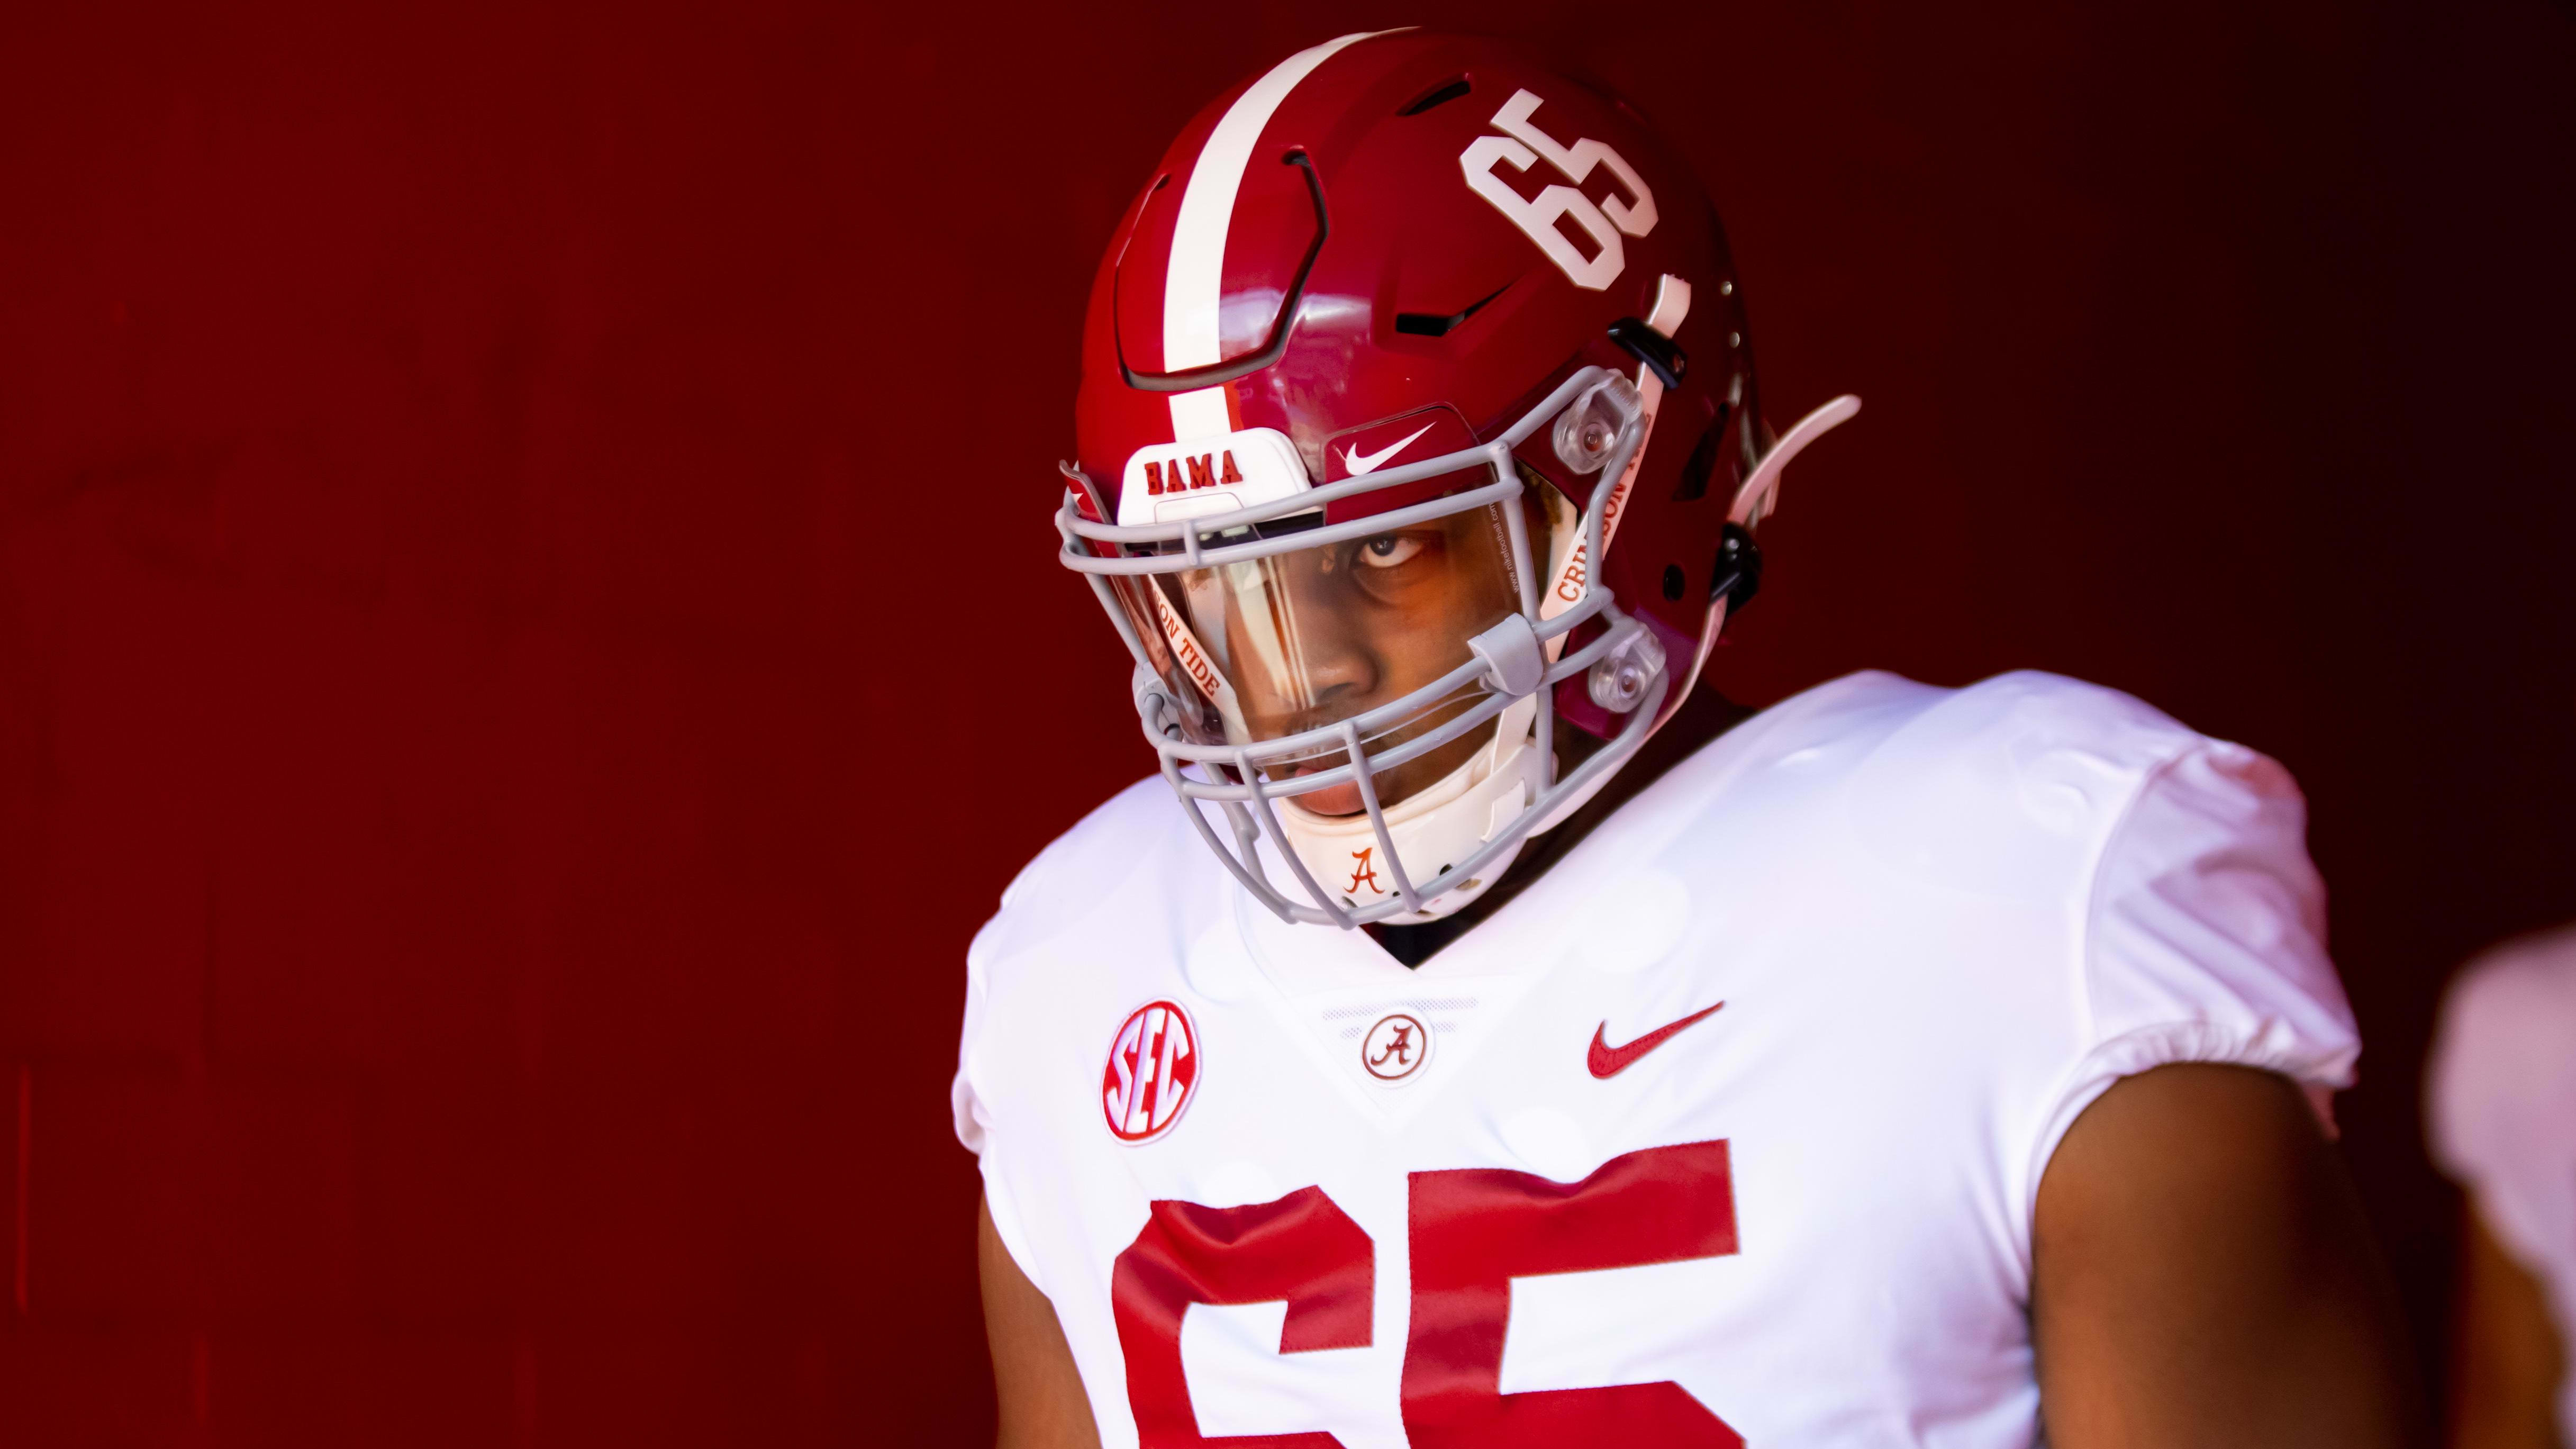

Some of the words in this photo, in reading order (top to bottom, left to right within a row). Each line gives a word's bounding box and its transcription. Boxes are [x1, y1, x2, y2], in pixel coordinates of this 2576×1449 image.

[1459, 88, 1658, 291] 65
[1144, 449, 1243, 495] BAMA
[1180, 637, 1220, 696] TIDE
[1343, 847, 1385, 894] A
[1106, 1007, 1190, 1133] SEC
[1371, 1024, 1413, 1066] A
[1110, 1138, 1746, 1449] 65
